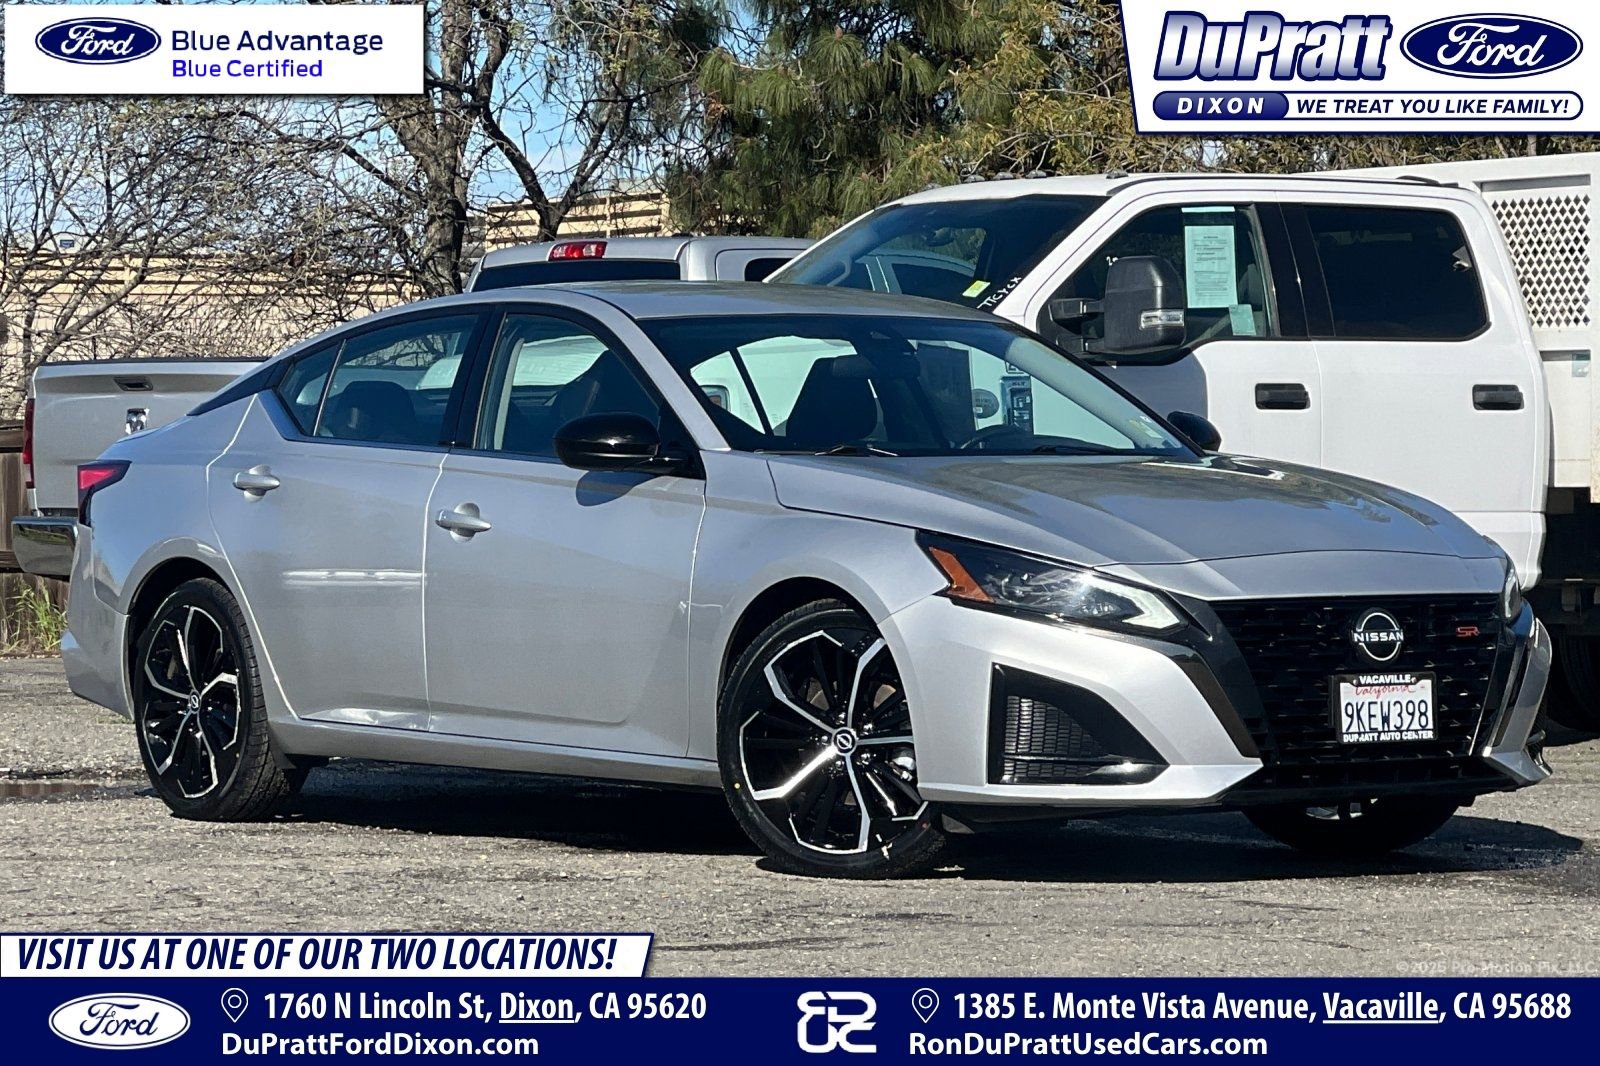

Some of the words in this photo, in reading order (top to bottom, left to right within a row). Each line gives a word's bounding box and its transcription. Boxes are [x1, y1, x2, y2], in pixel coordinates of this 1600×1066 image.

[1353, 630, 1404, 643] NISSAN
[1456, 626, 1480, 637] SR
[1358, 674, 1412, 685] VACAVILLE
[1355, 685, 1416, 699] California
[1344, 699, 1430, 732] 9KEW398
[1379, 731, 1401, 742] AUTO
[1402, 730, 1434, 740] CENTER
